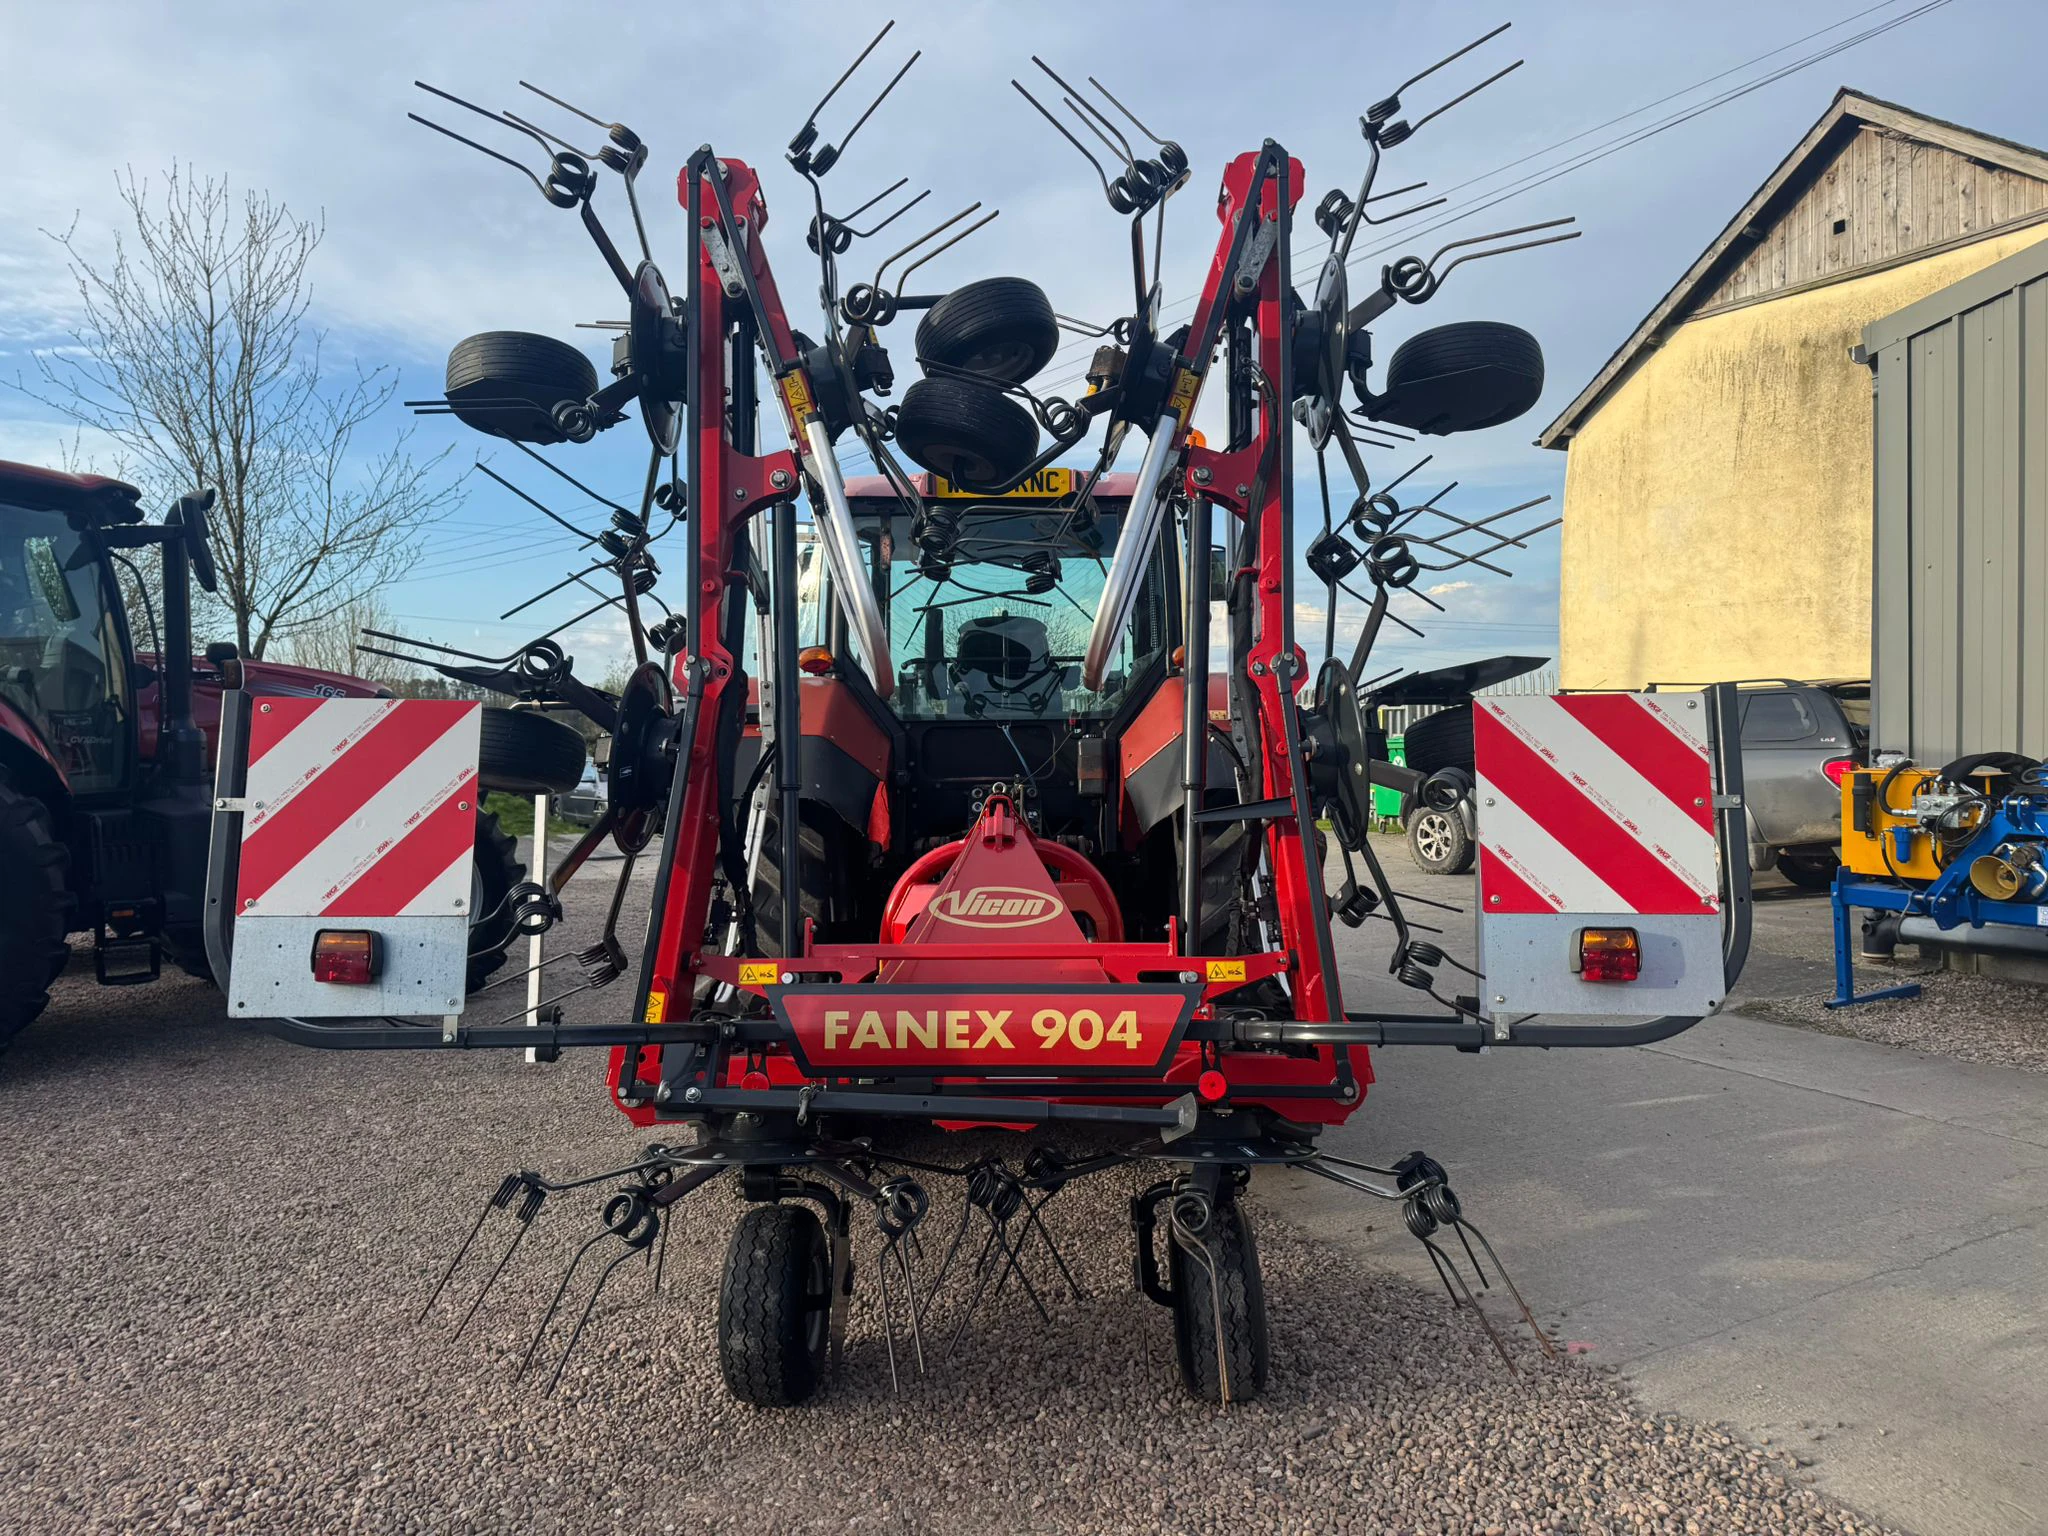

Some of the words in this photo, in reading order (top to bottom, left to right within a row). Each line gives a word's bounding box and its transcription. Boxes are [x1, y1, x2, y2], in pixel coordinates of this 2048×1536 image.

[314, 684, 346, 698] 165
[947, 887, 1046, 915] Vicon
[824, 1010, 1015, 1049] FANEX
[1031, 1009, 1142, 1050] 904
